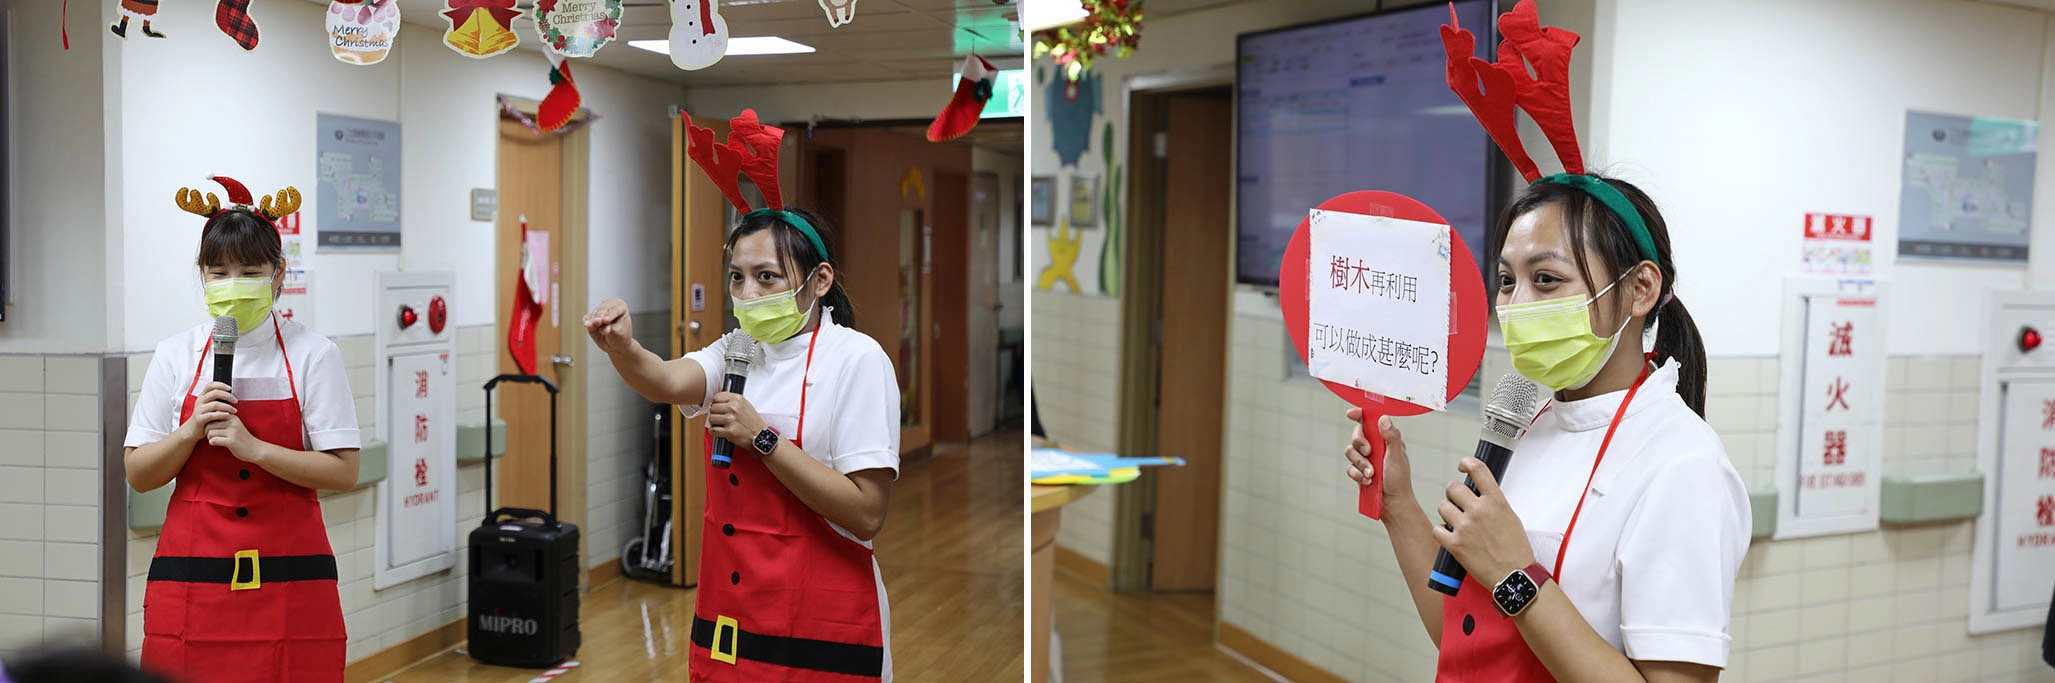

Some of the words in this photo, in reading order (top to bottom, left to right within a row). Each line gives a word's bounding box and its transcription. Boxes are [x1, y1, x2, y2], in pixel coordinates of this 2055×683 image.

[552, 12, 606, 25] Christmas
[560, 2, 597, 13] Merry
[333, 24, 368, 38] Merry
[335, 35, 389, 48] Christmas
[1330, 255, 1417, 303] 樹木再利用
[1314, 323, 1439, 375] 可以做成甚麼呢?
[1823, 321, 1854, 467] 滅火器
[415, 369, 429, 488] 消防栓
